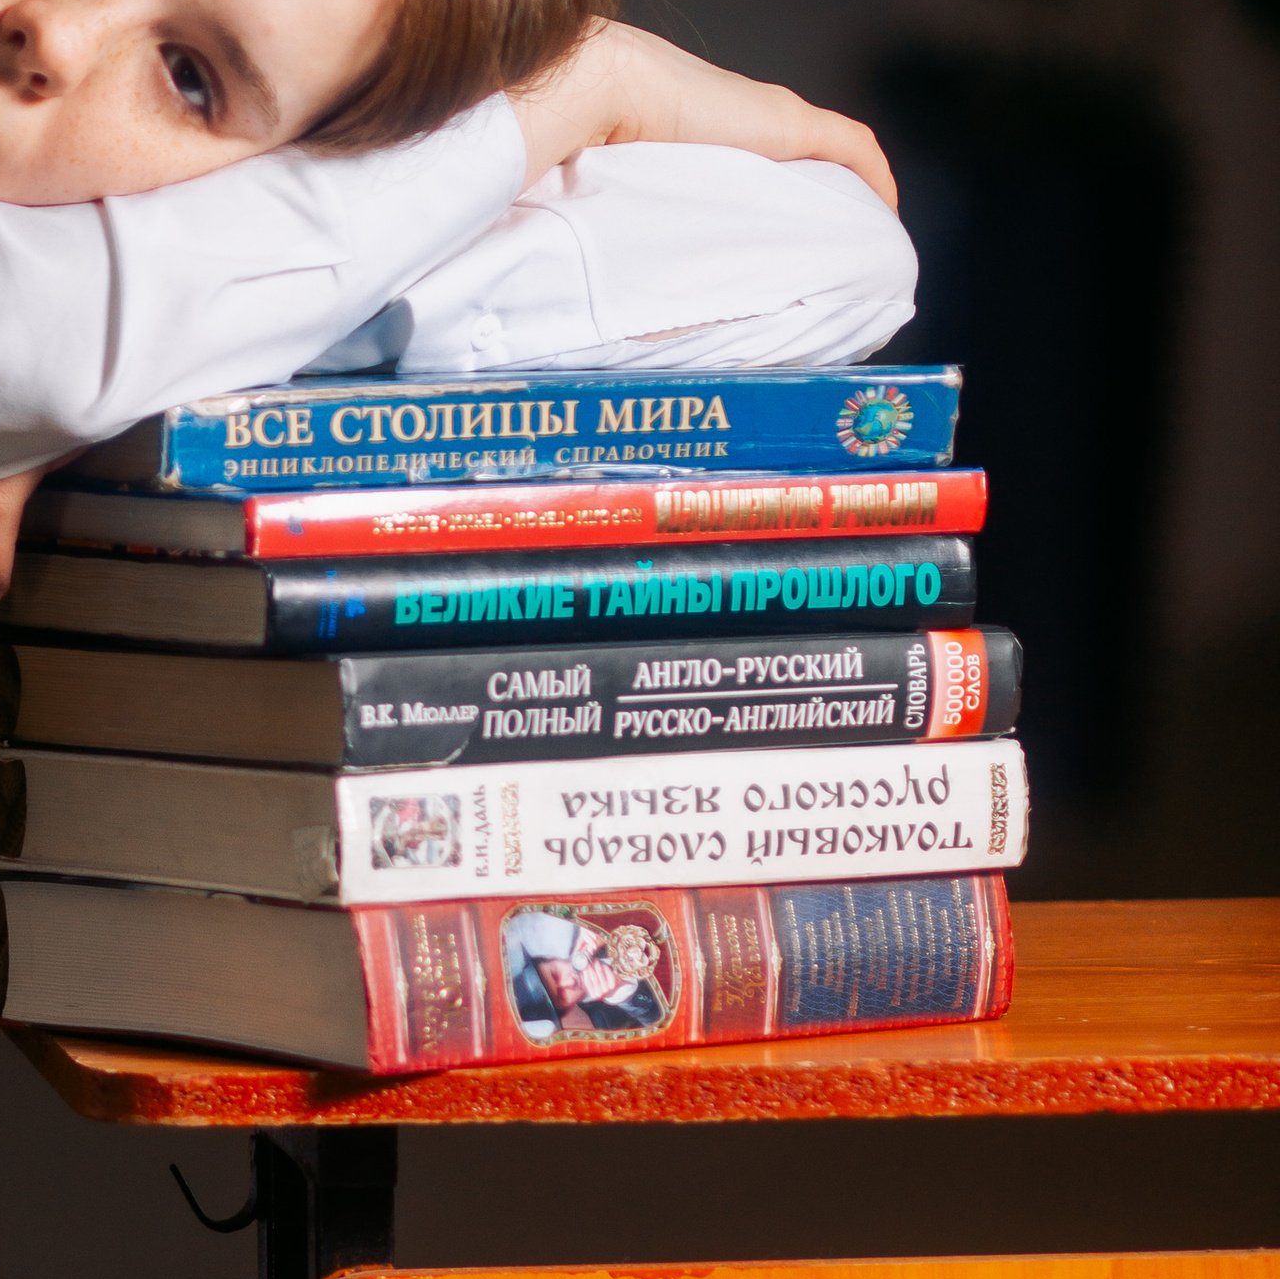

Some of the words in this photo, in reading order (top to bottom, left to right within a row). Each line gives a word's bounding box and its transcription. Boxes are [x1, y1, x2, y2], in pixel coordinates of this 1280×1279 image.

[224, 408, 314, 448] ВСЕ
[330, 399, 580, 444] СТОЛИЦЫ
[596, 394, 731, 435] МИРА
[224, 445, 536, 478] ЭНЦИКЛОПЕДИЧЕСКИЙ
[554, 440, 729, 464] СПРАВОЧНИК
[654, 486, 823, 534] ЗНАМЕНИТОСТИ
[830, 482, 938, 528] МИРОВЫЕ
[394, 576, 574, 625] ВЕЛИКИЕ
[582, 559, 721, 617] ТАЙНЫ
[731, 562, 942, 612] ПРОШЛОГО
[487, 664, 591, 702] САМЫЙ
[633, 646, 864, 689] АНГЛО-РУССКИЙ
[904, 642, 927, 729] СЛОВАРЬ
[966, 654, 981, 710] СЛОВ
[482, 701, 602, 740] ПОЛНЫЙ
[613, 694, 896, 740] РУССКО-АНГЛИЙСКИЙ
